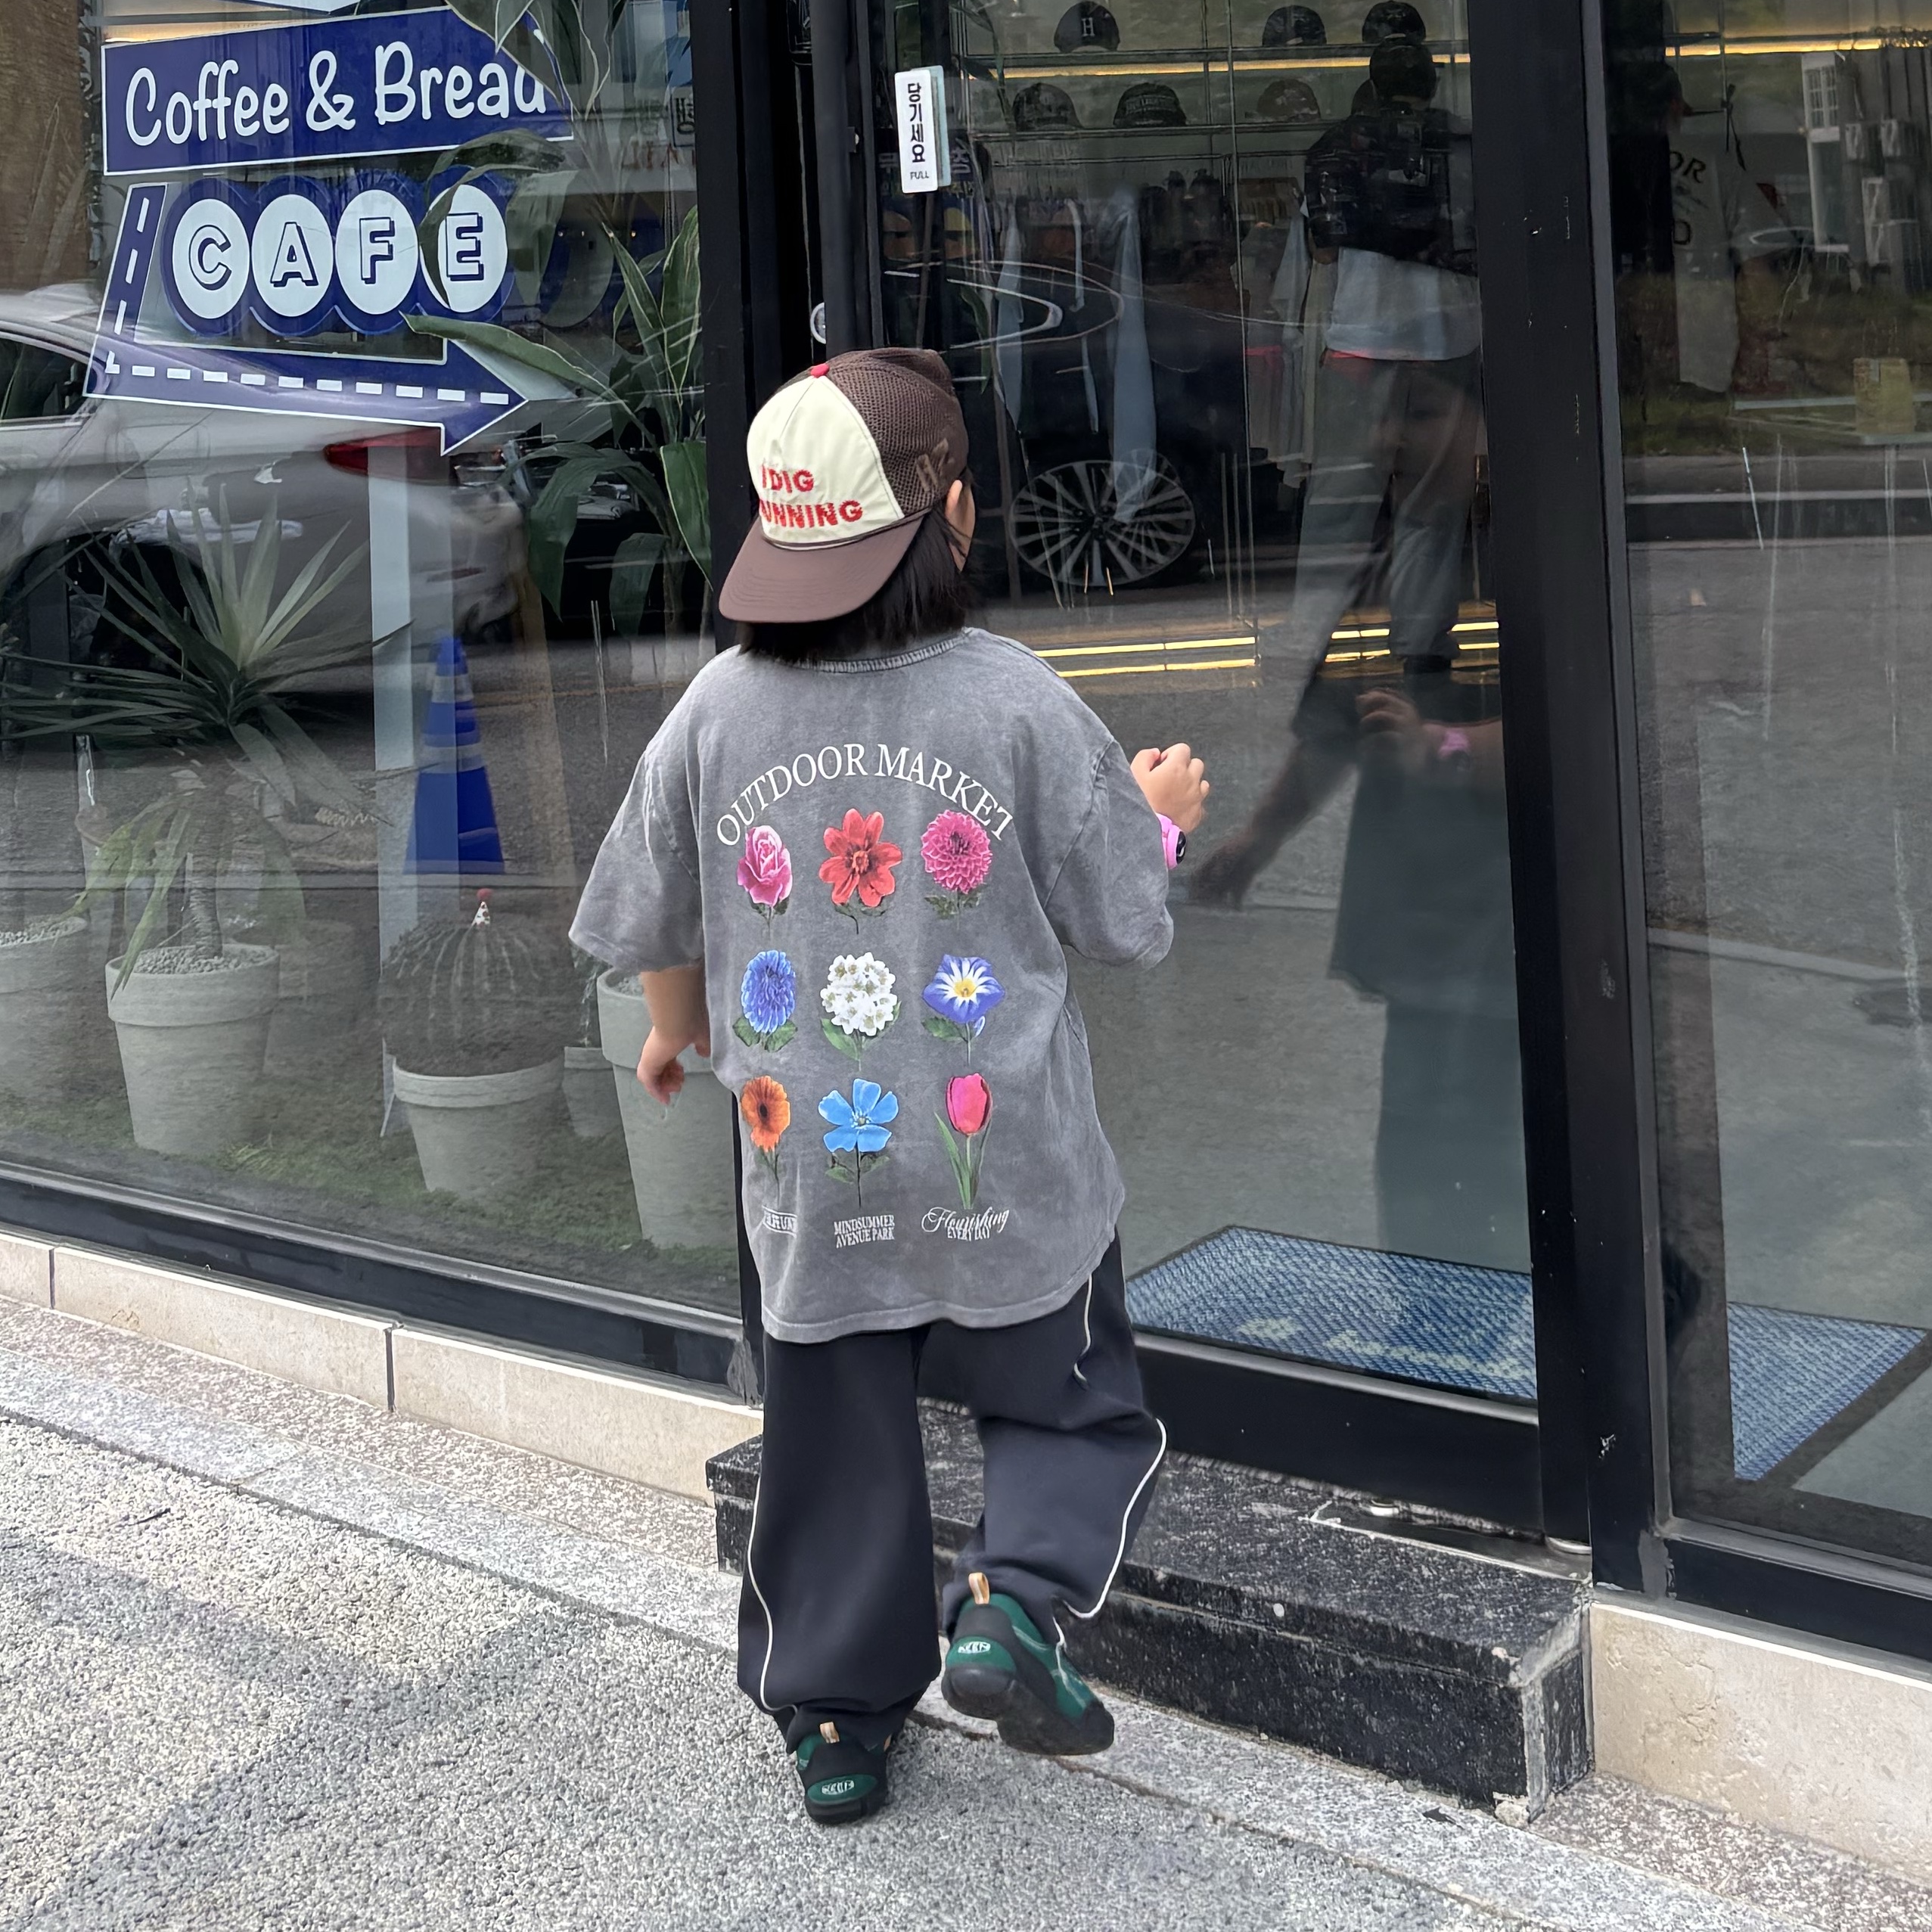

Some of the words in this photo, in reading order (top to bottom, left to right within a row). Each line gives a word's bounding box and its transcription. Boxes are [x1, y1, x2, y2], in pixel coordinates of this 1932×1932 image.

[125, 58, 290, 147] Coffee
[306, 49, 356, 132] &
[908, 82, 926, 163] 당기세요
[187, 212, 485, 292] CAFE
[758, 498, 863, 529] UNNING
[768, 469, 815, 494] DIG
[716, 743, 868, 846] OUTDOOR
[874, 744, 1014, 841] MARKET
[836, 1228, 871, 1249] AVENUE
[871, 1226, 896, 1241] PARK
